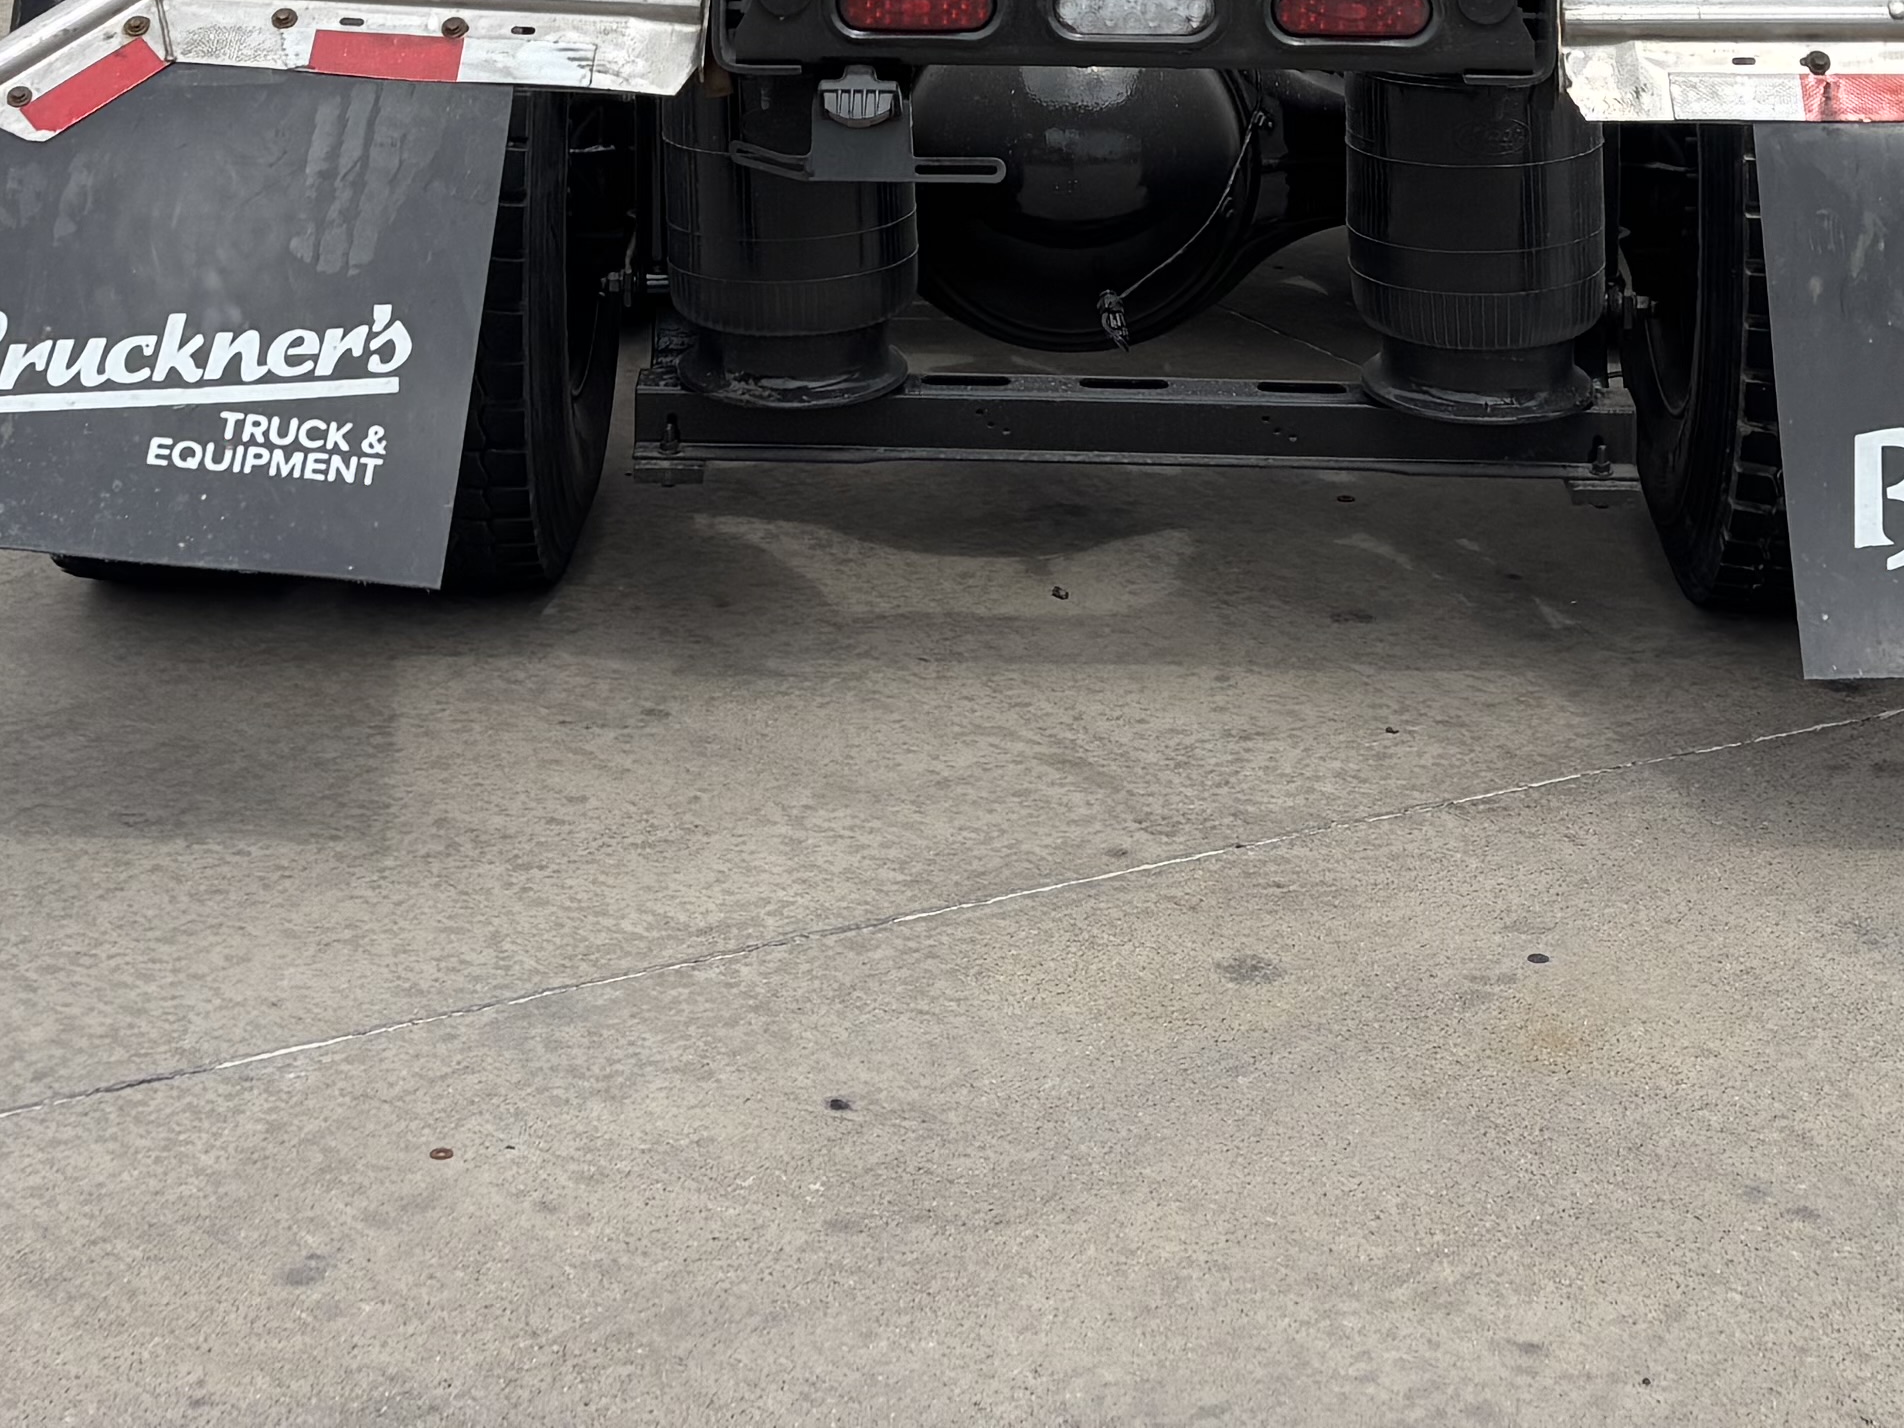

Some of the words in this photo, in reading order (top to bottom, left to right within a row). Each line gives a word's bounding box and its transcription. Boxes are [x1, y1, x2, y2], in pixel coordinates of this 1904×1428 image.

[219, 410, 354, 452] TRUCK
[360, 424, 387, 455] &
[146, 436, 384, 486] EQUIPMENT
